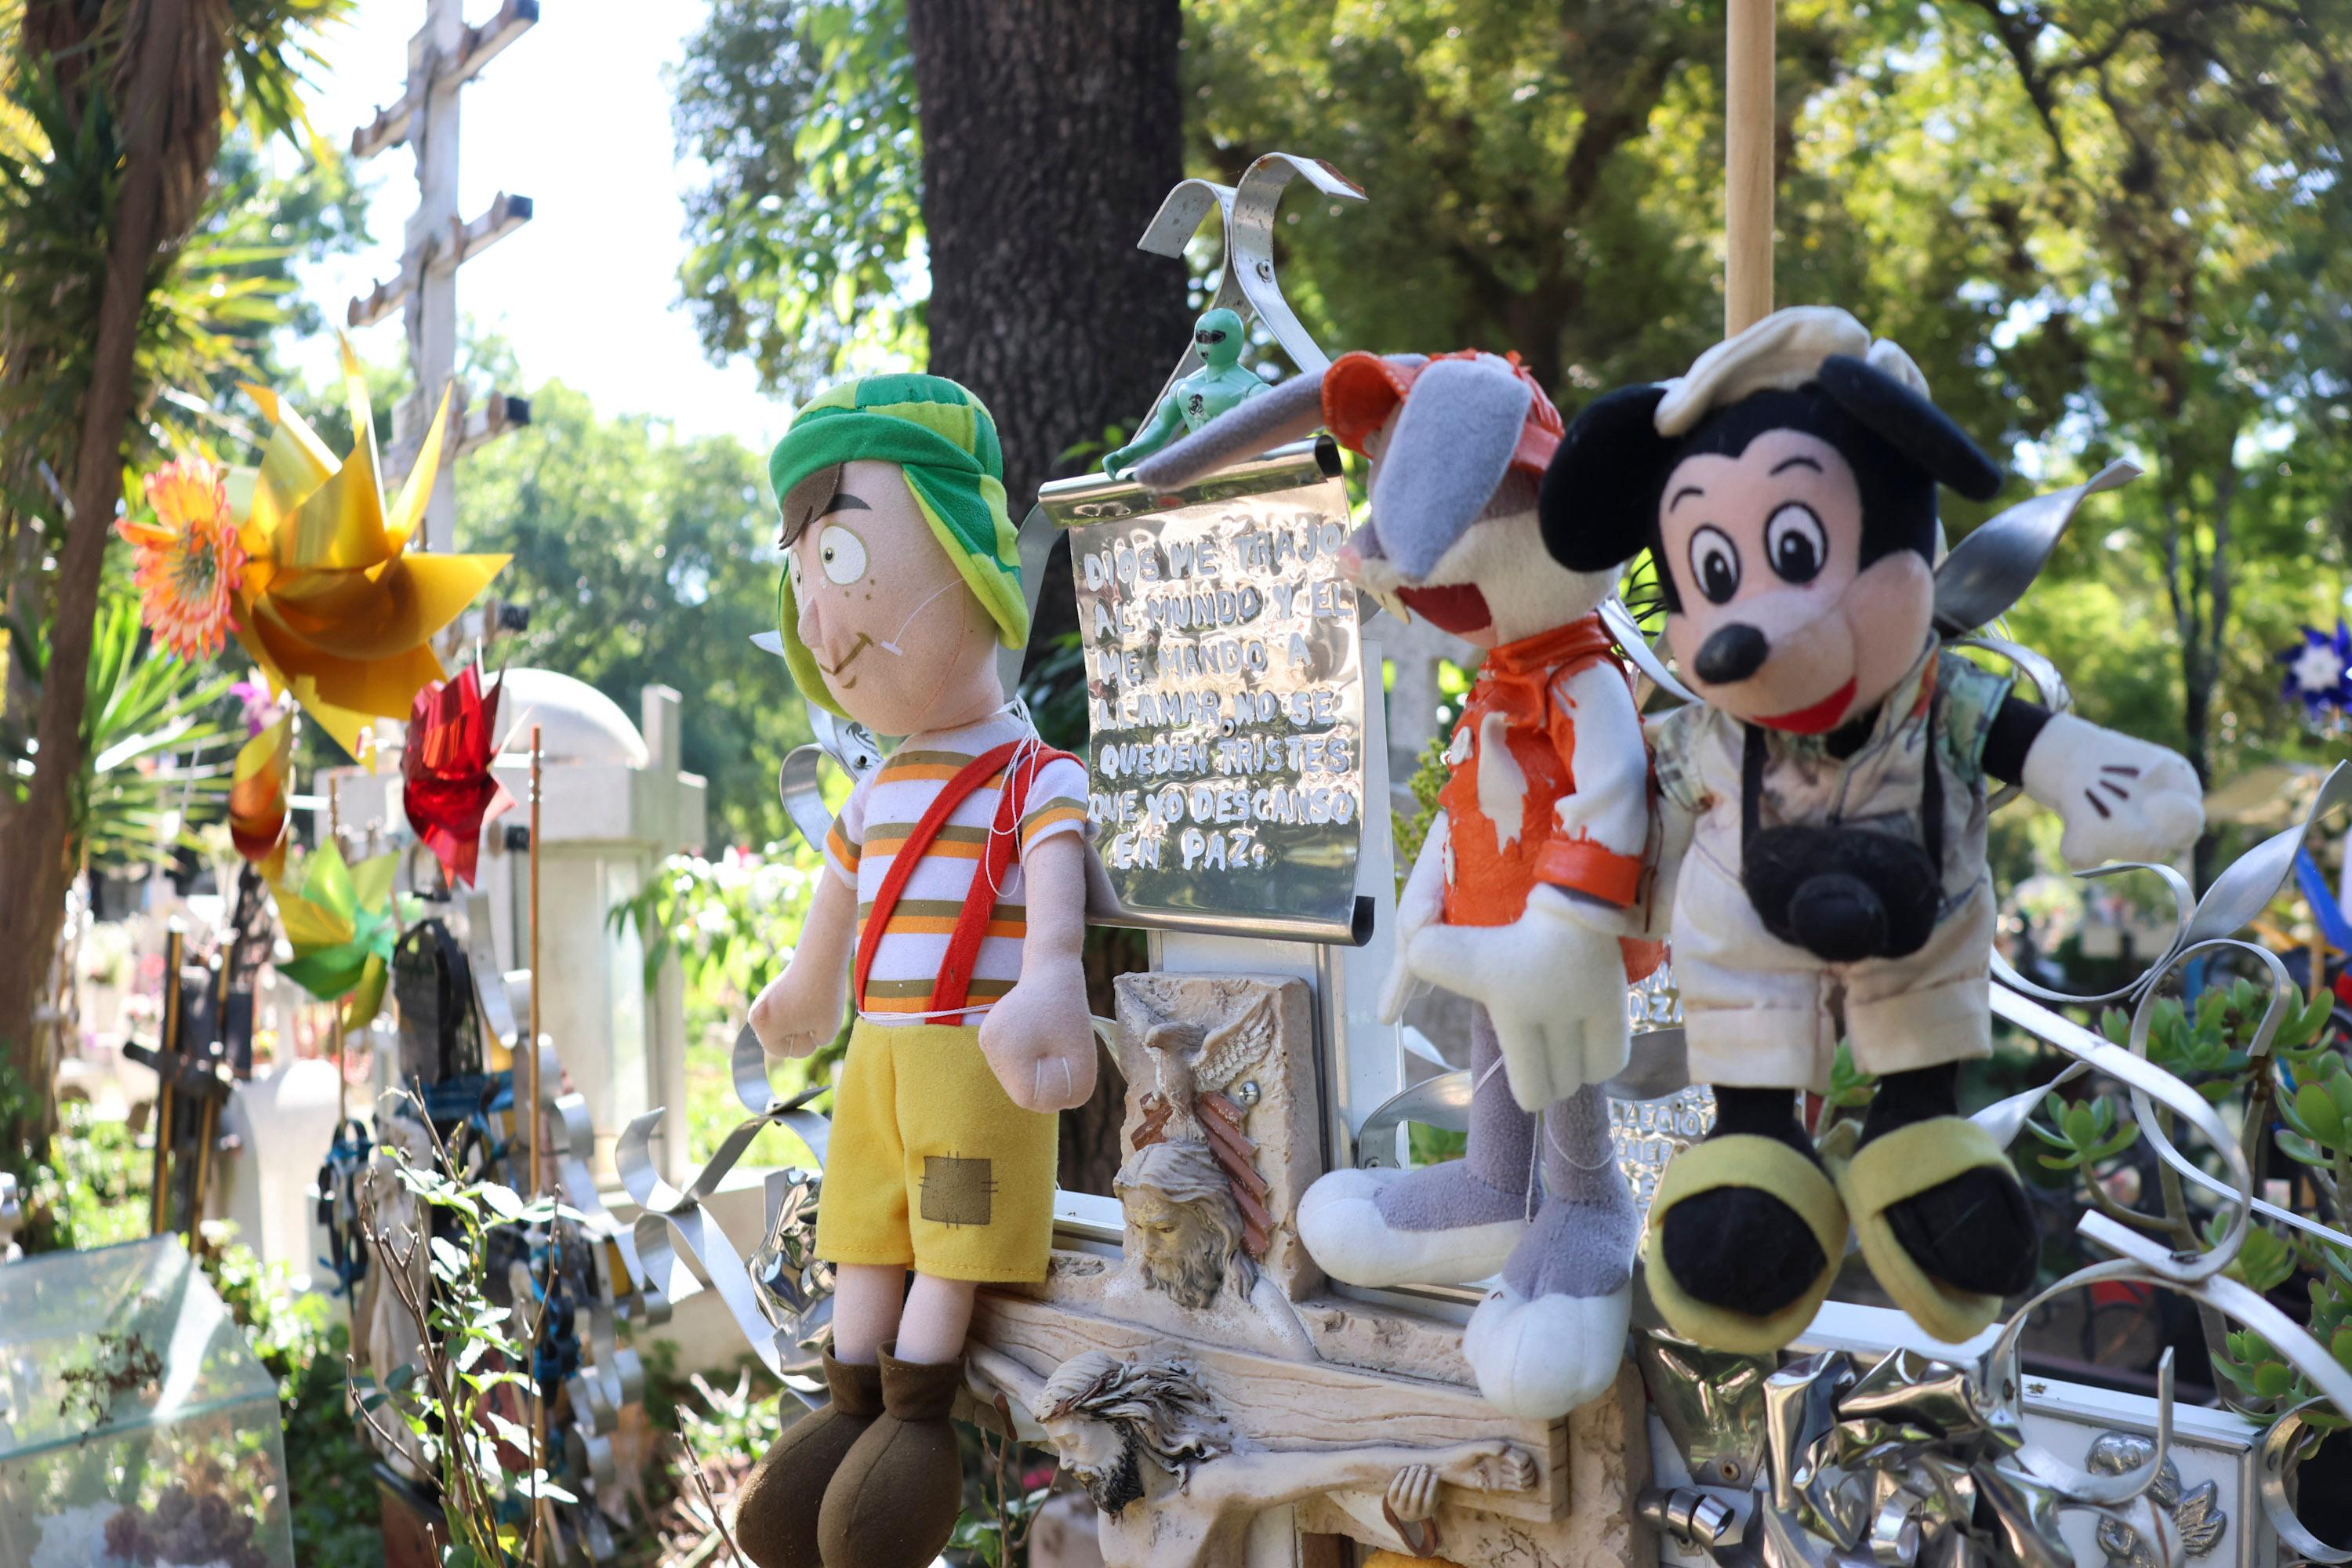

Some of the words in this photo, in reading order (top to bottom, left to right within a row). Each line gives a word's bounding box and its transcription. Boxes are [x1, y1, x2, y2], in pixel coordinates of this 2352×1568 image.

[1084, 545, 1160, 592] DIOS
[1170, 541, 1217, 579] ME
[1232, 523, 1342, 572] TRAJO
[1094, 602, 1134, 639] AL
[1148, 586, 1262, 629] MUNDO
[1272, 583, 1293, 621] Y
[1311, 581, 1353, 618] EL
[1098, 648, 1142, 686] ME
[1158, 639, 1268, 681] MANDO
[1287, 632, 1312, 667] A
[1098, 690, 1218, 730] LLAMAR
[1233, 690, 1276, 726] NO
[1290, 691, 1335, 726] SE
[1099, 743, 1207, 779] QUEDEN
[1217, 735, 1350, 776] TRISTES
[1087, 790, 1139, 824] QUE
[1145, 790, 1185, 826] YO
[1192, 786, 1355, 826] DESCANSO
[1113, 833, 1160, 870] EN
